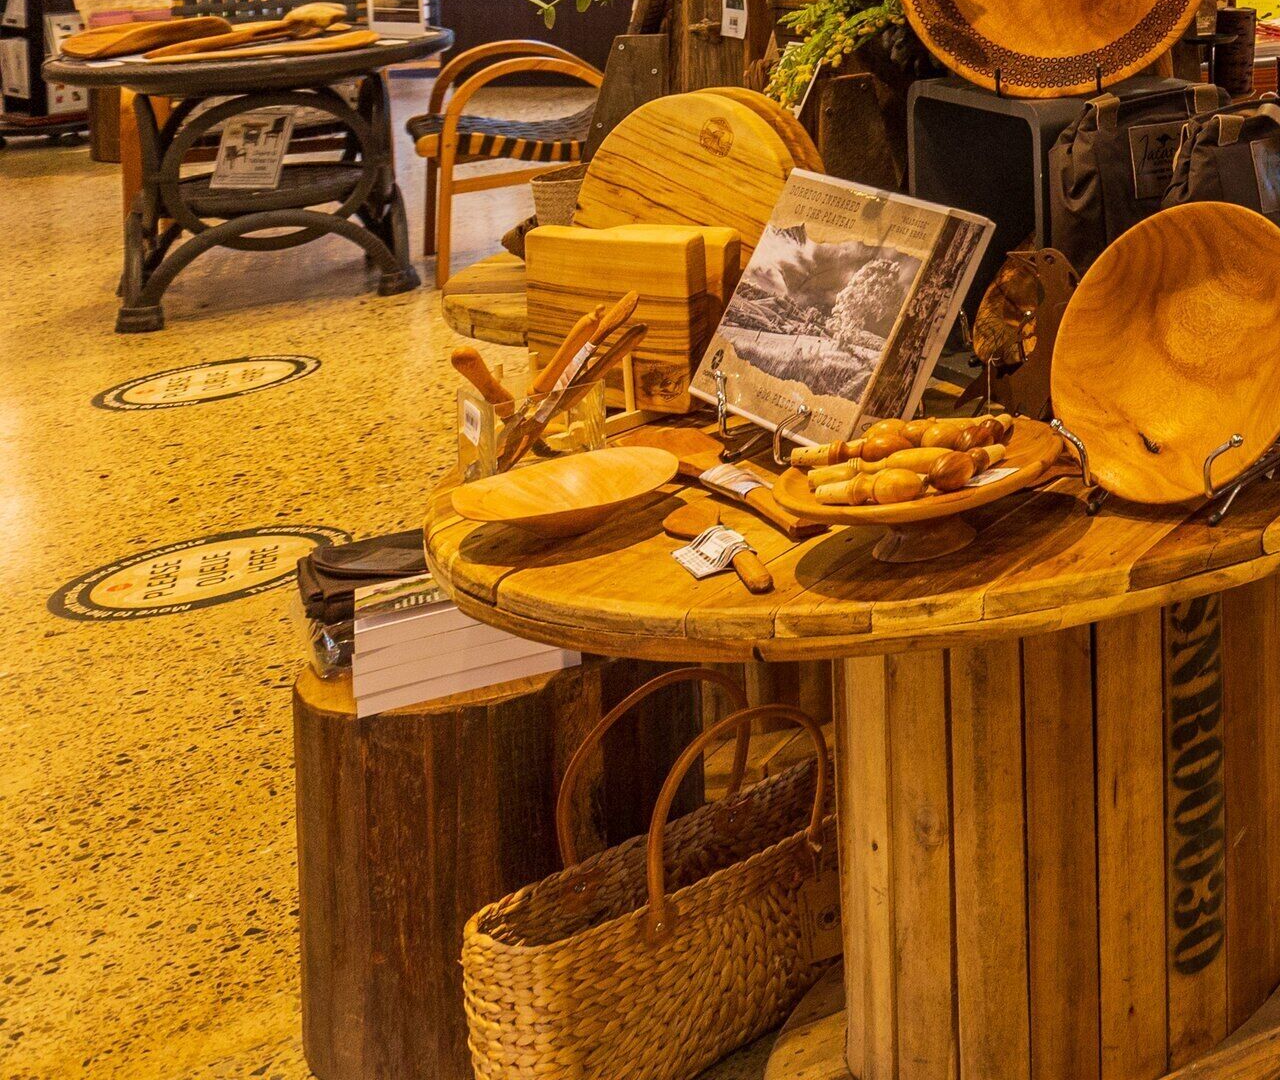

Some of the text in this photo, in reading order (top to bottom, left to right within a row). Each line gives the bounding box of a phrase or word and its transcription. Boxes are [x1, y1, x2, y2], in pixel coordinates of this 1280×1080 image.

[789, 185, 860, 213] DORRIGO INFRARED
[806, 207, 857, 229] THE PLATEAU
[811, 410, 843, 432] PUZZLE
[196, 550, 232, 587] QUEUE
[247, 545, 279, 574] HERE
[142, 559, 182, 601] PLEASE
[245, 573, 298, 595] Thank
[136, 603, 192, 617] Move
